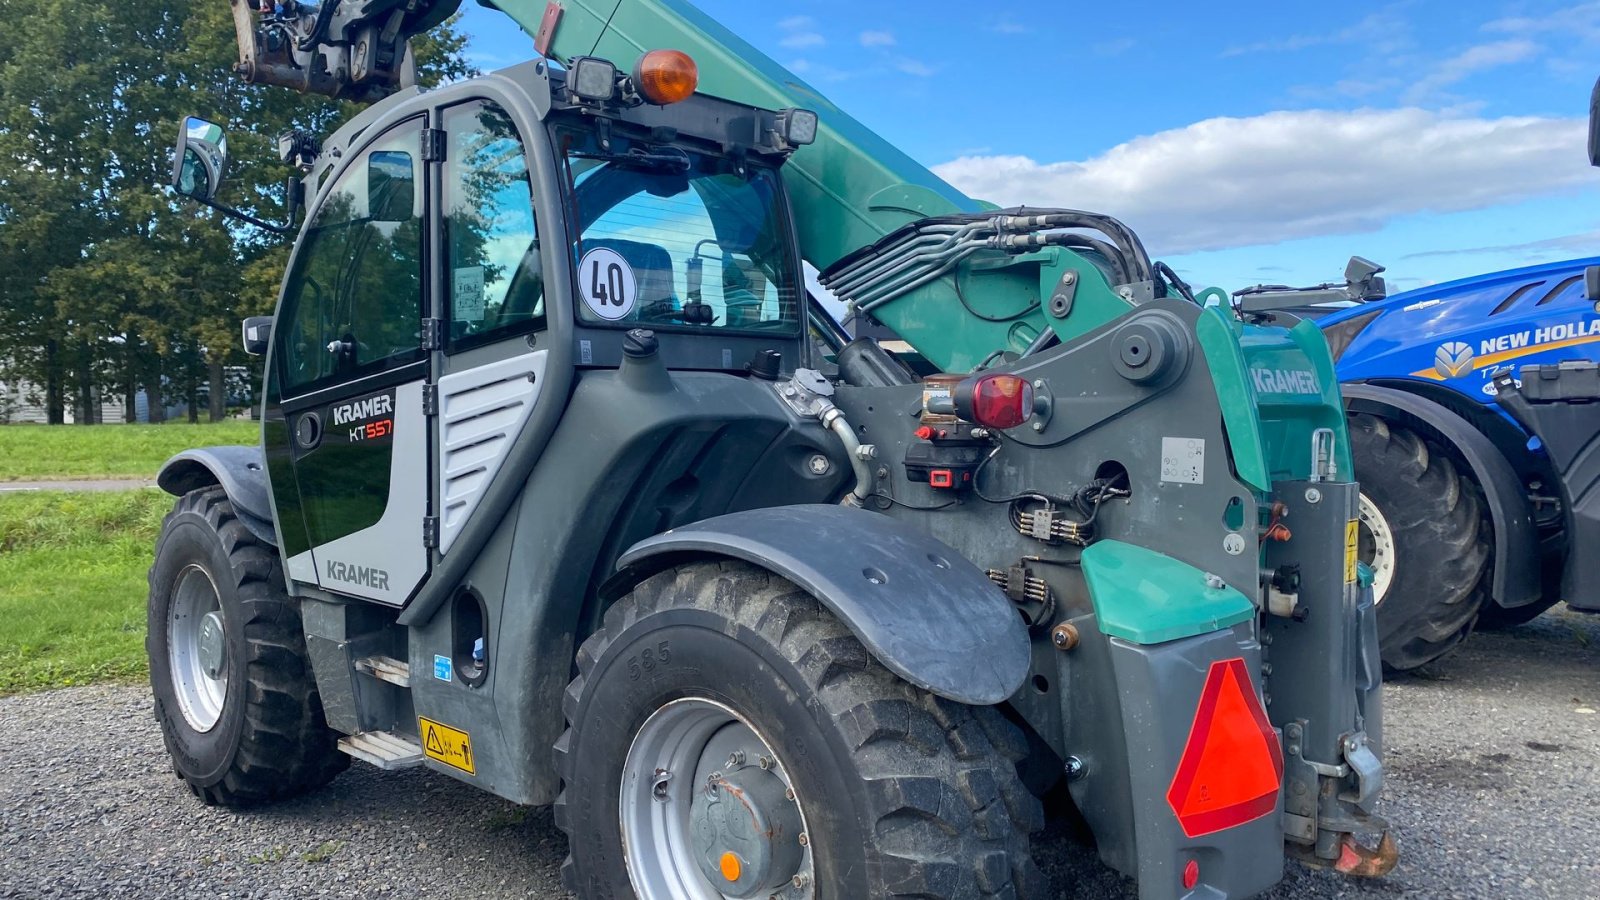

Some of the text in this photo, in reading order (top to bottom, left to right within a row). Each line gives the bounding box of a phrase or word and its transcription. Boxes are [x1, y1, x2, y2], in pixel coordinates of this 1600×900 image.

[592, 260, 625, 307] 40
[1481, 331, 1530, 355] NEW
[1250, 368, 1321, 394] KRAMER
[333, 394, 393, 426] KRAMER
[349, 419, 392, 442] KT557
[327, 559, 390, 591] KRAMER
[627, 640, 673, 681] 585
